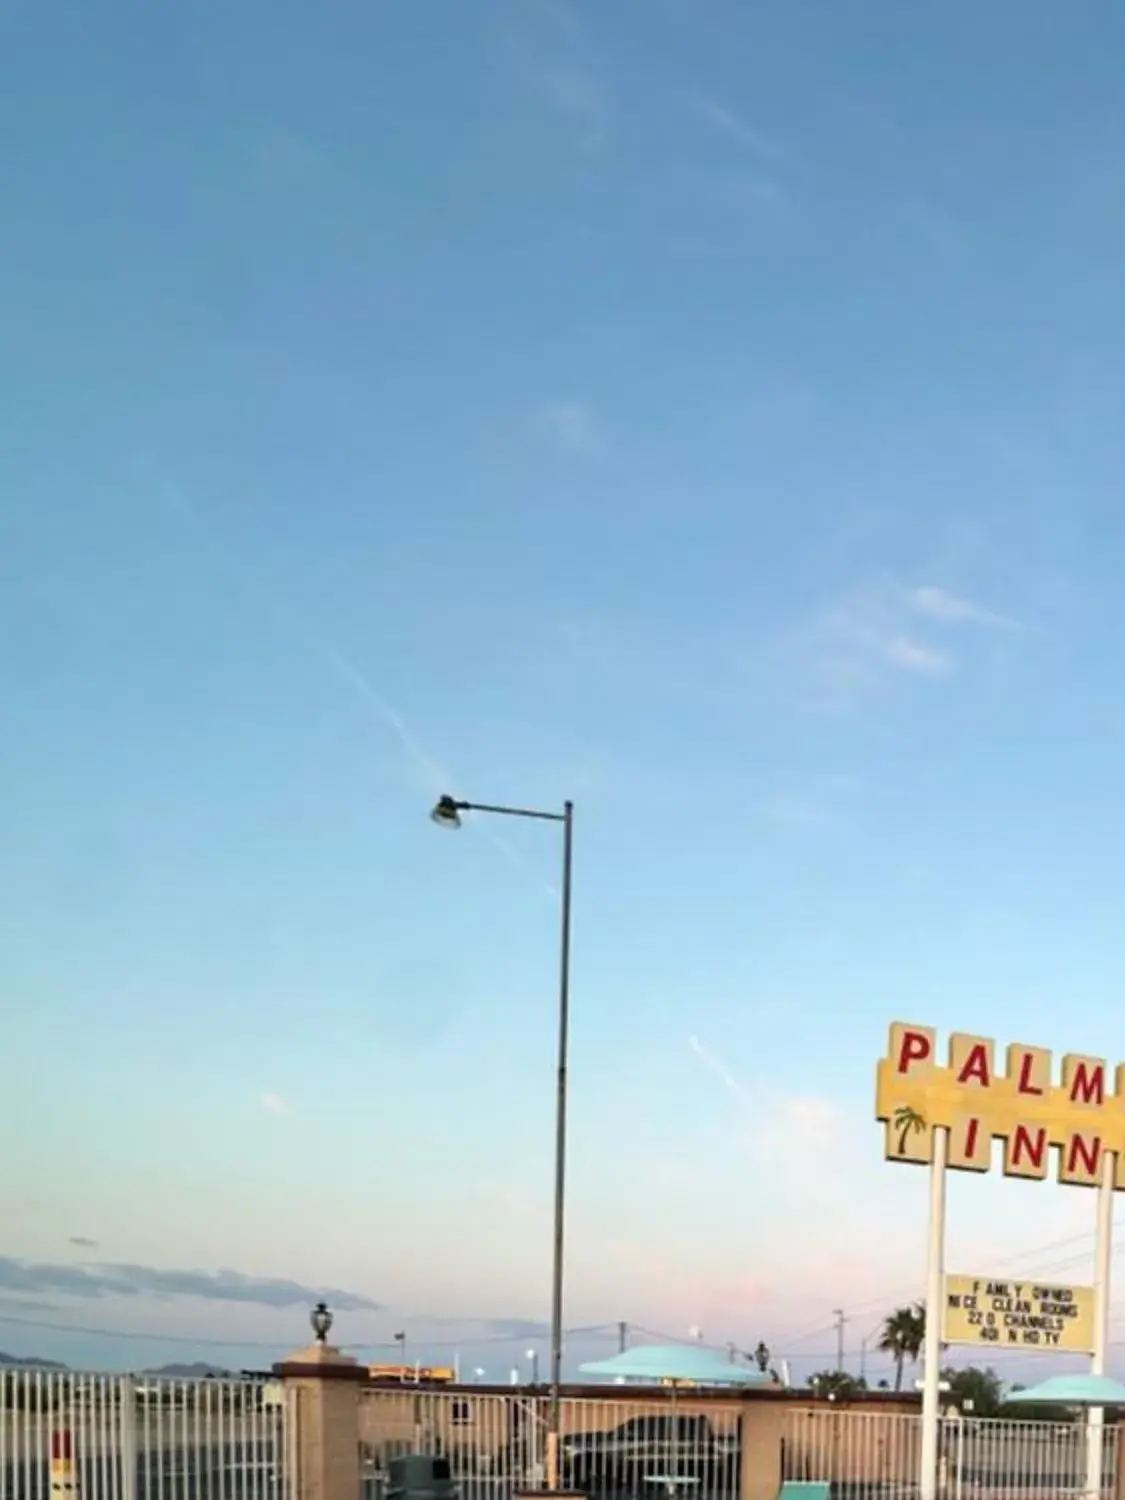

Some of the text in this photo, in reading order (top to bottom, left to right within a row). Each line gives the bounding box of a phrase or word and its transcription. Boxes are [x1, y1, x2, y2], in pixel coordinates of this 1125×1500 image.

[964, 1118, 1100, 1176] INN
[992, 1299, 1031, 1313] CLEAN
[1040, 1303, 1078, 1317] ROOMS
[1003, 1313, 1064, 1331] CHANNELS
